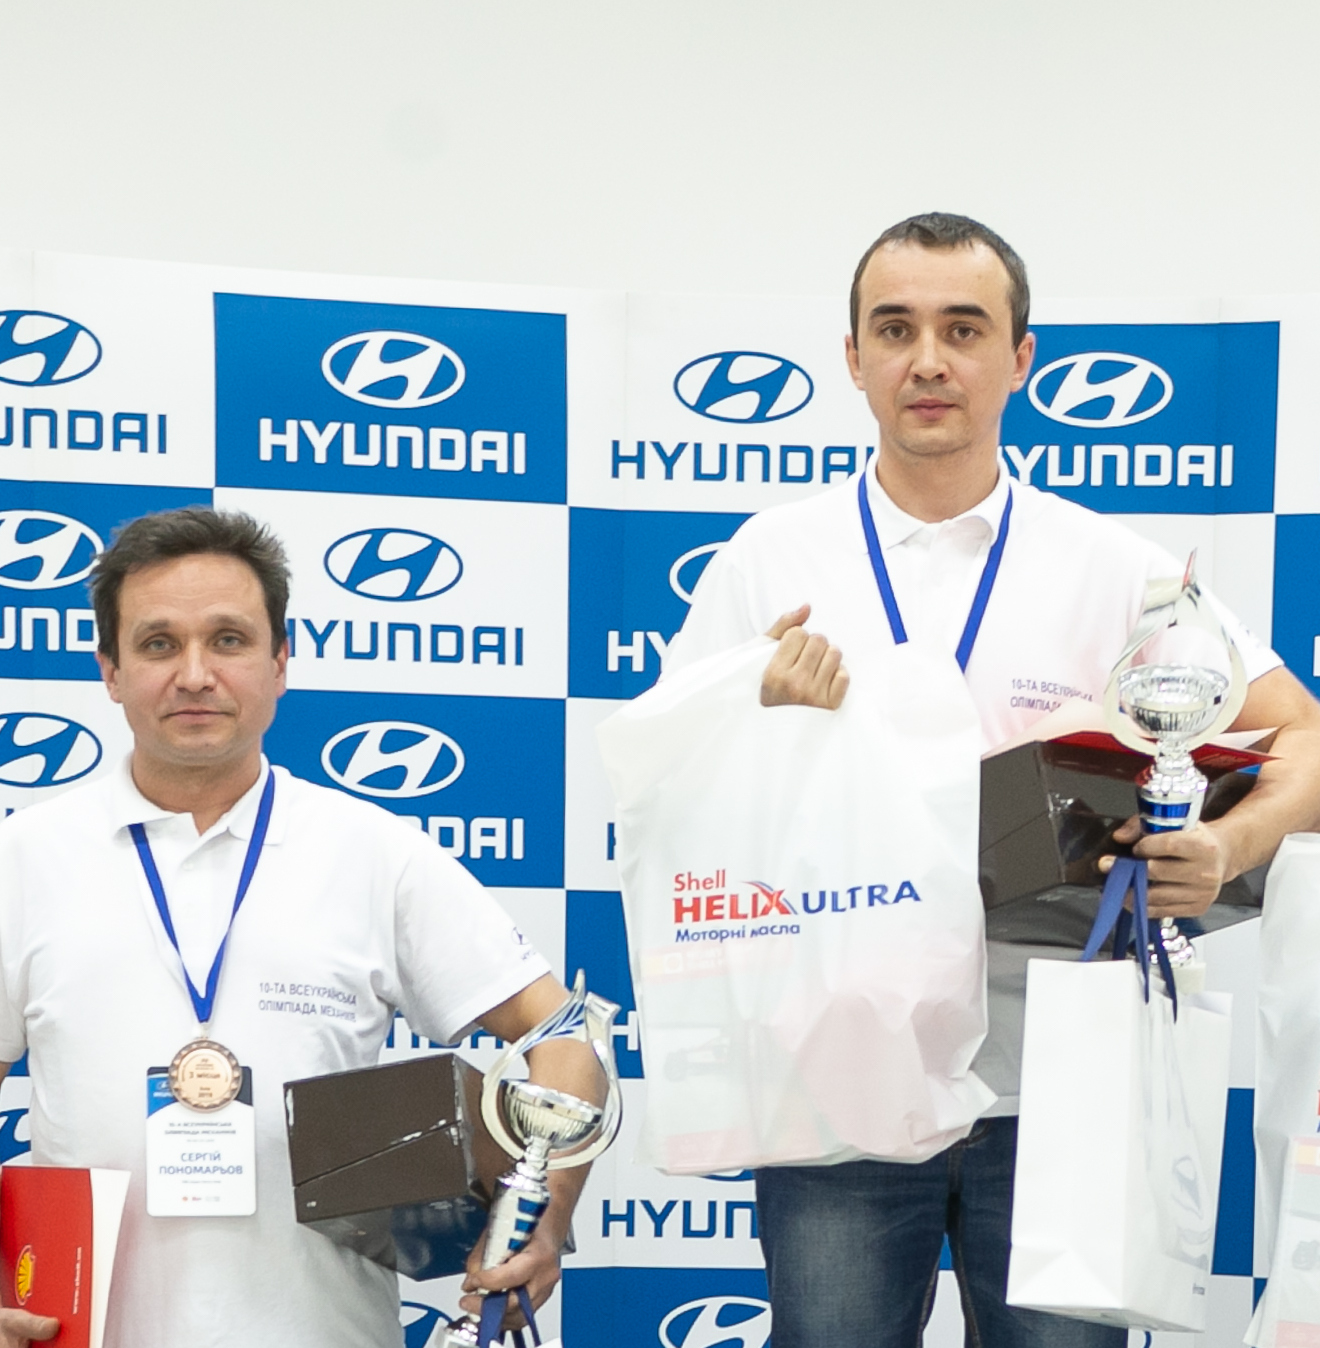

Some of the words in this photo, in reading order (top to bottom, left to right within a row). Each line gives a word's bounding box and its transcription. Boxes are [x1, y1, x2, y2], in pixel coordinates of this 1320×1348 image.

[259, 417, 526, 474] HYUNDAI
[998, 444, 1234, 487] YUNDAI
[286, 617, 524, 666] YUNDAI
[674, 869, 726, 893] Shell
[673, 882, 795, 924] HELIX
[801, 880, 922, 915] ULTRA
[675, 925, 746, 944] Моторні
[159, 1165, 243, 1175] ПОНОМАРЬОВ
[181, 1150, 221, 1162] СЕРГІЙ
[602, 1199, 759, 1240] HYUN
